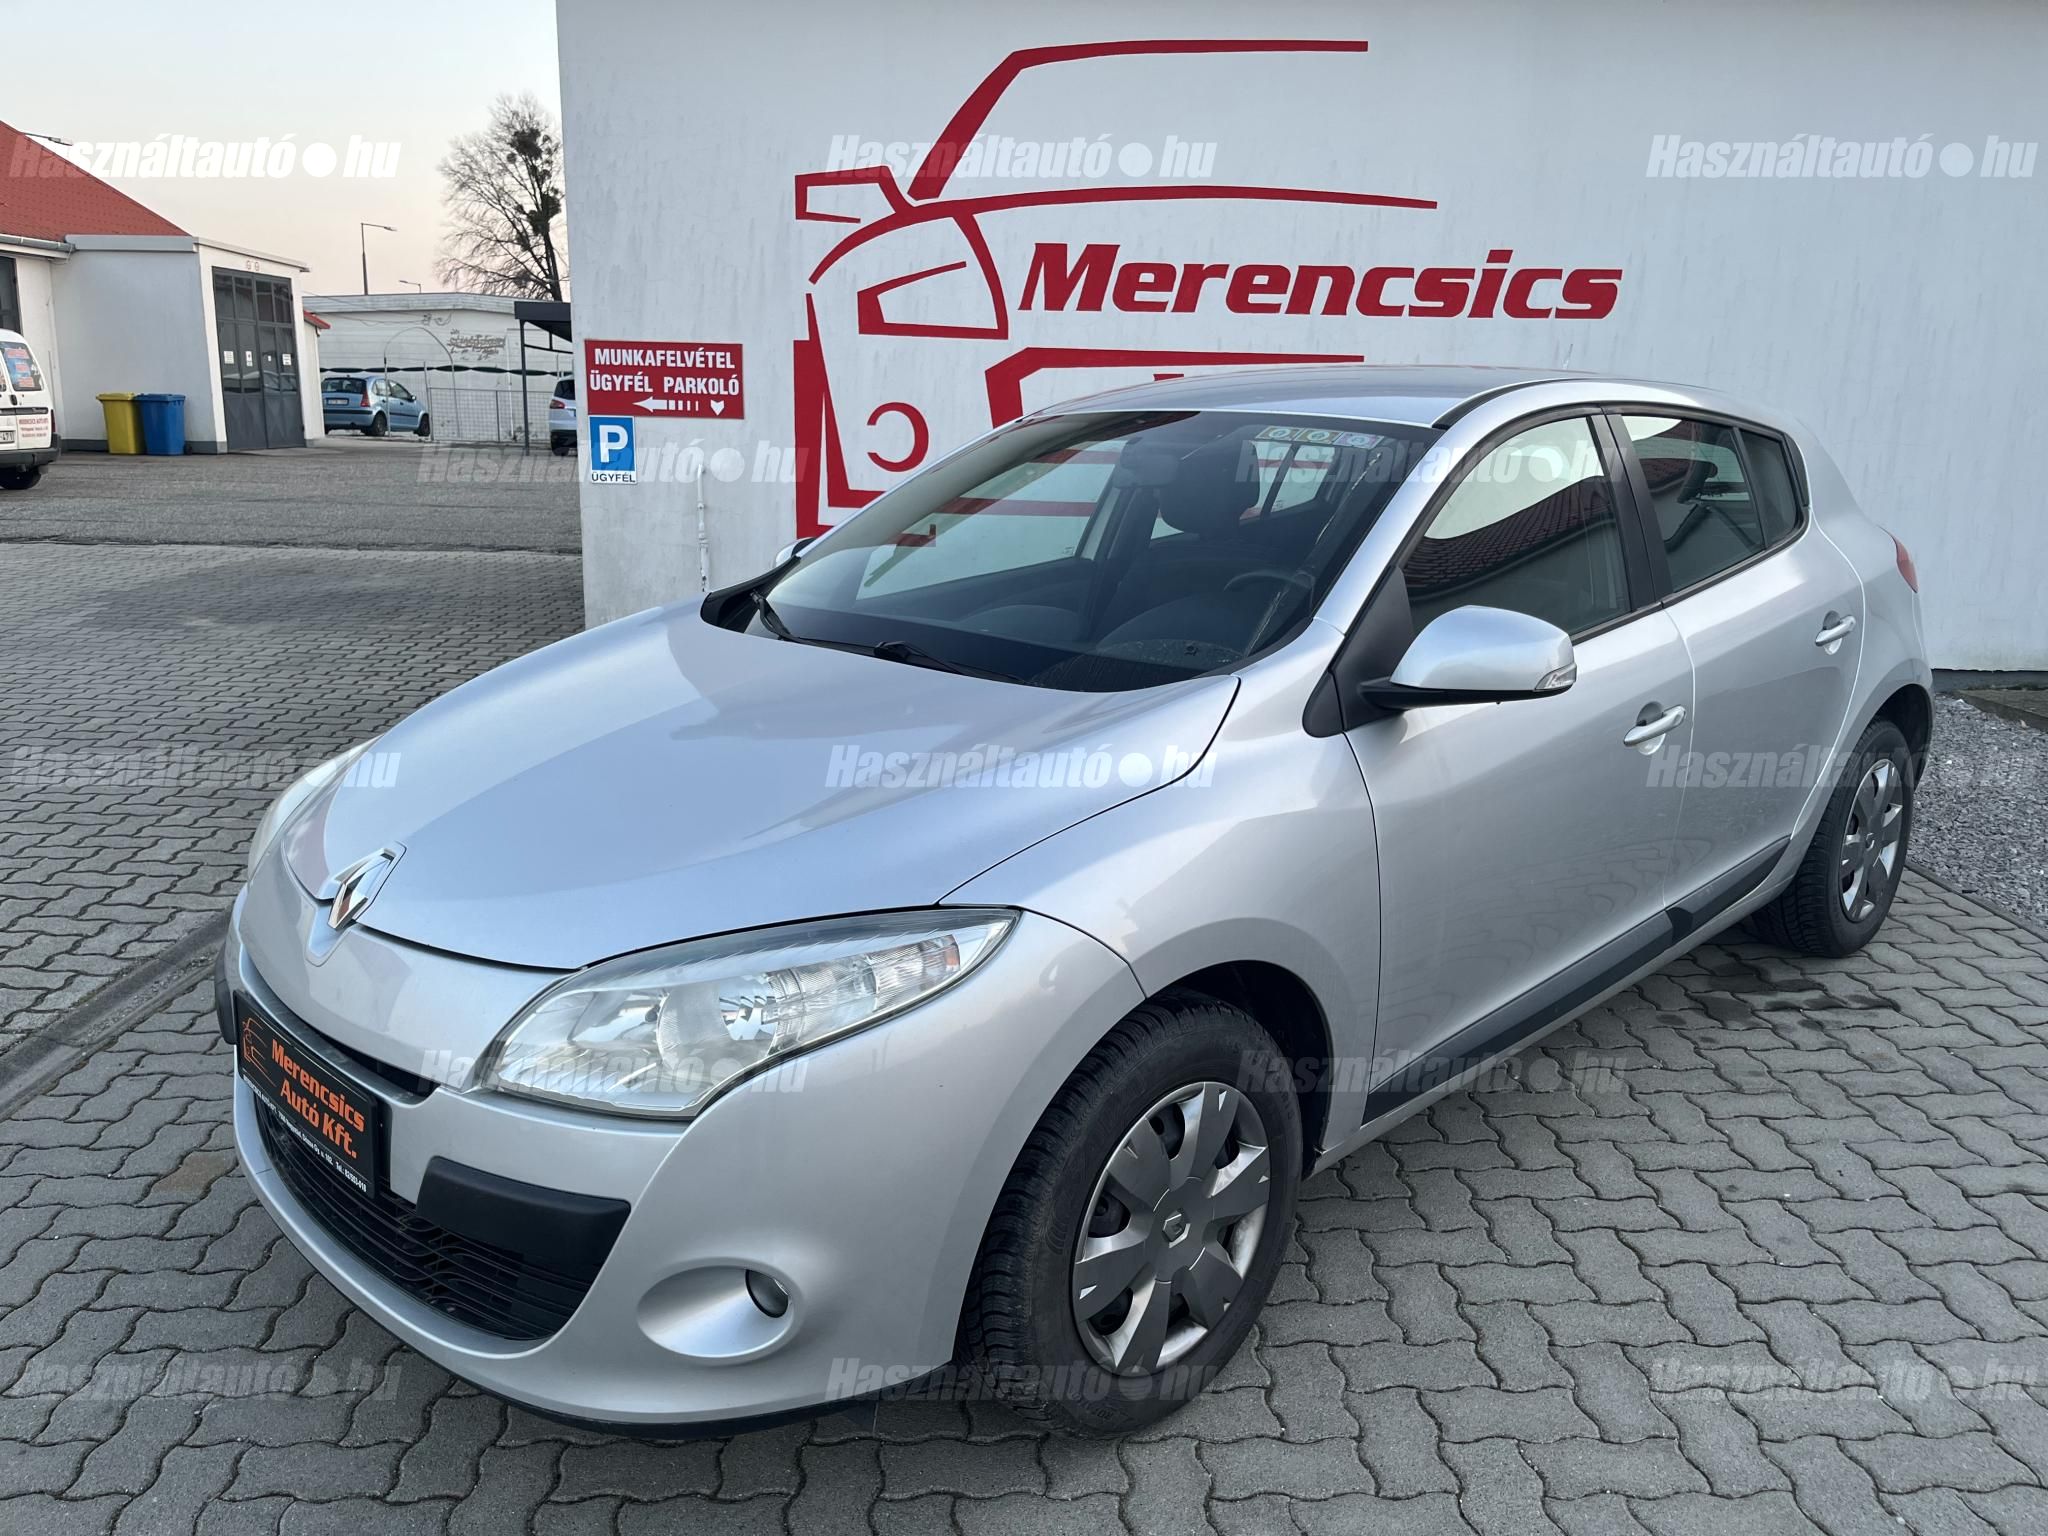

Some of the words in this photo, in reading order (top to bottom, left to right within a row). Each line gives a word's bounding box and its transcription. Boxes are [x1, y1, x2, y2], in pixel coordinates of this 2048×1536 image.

[1018, 242, 1623, 319] Merencsics
[594, 347, 736, 369] MUNKAFELVÉTEL
[590, 370, 654, 393] ÜGYFÉL
[663, 374, 740, 396] PARKOLÓ
[599, 424, 629, 463] P
[591, 470, 636, 483] ÜGYFÉL
[272, 1038, 365, 1133] Merencsics
[280, 1079, 320, 1128] Autó
[322, 1112, 358, 1159] Kft.
